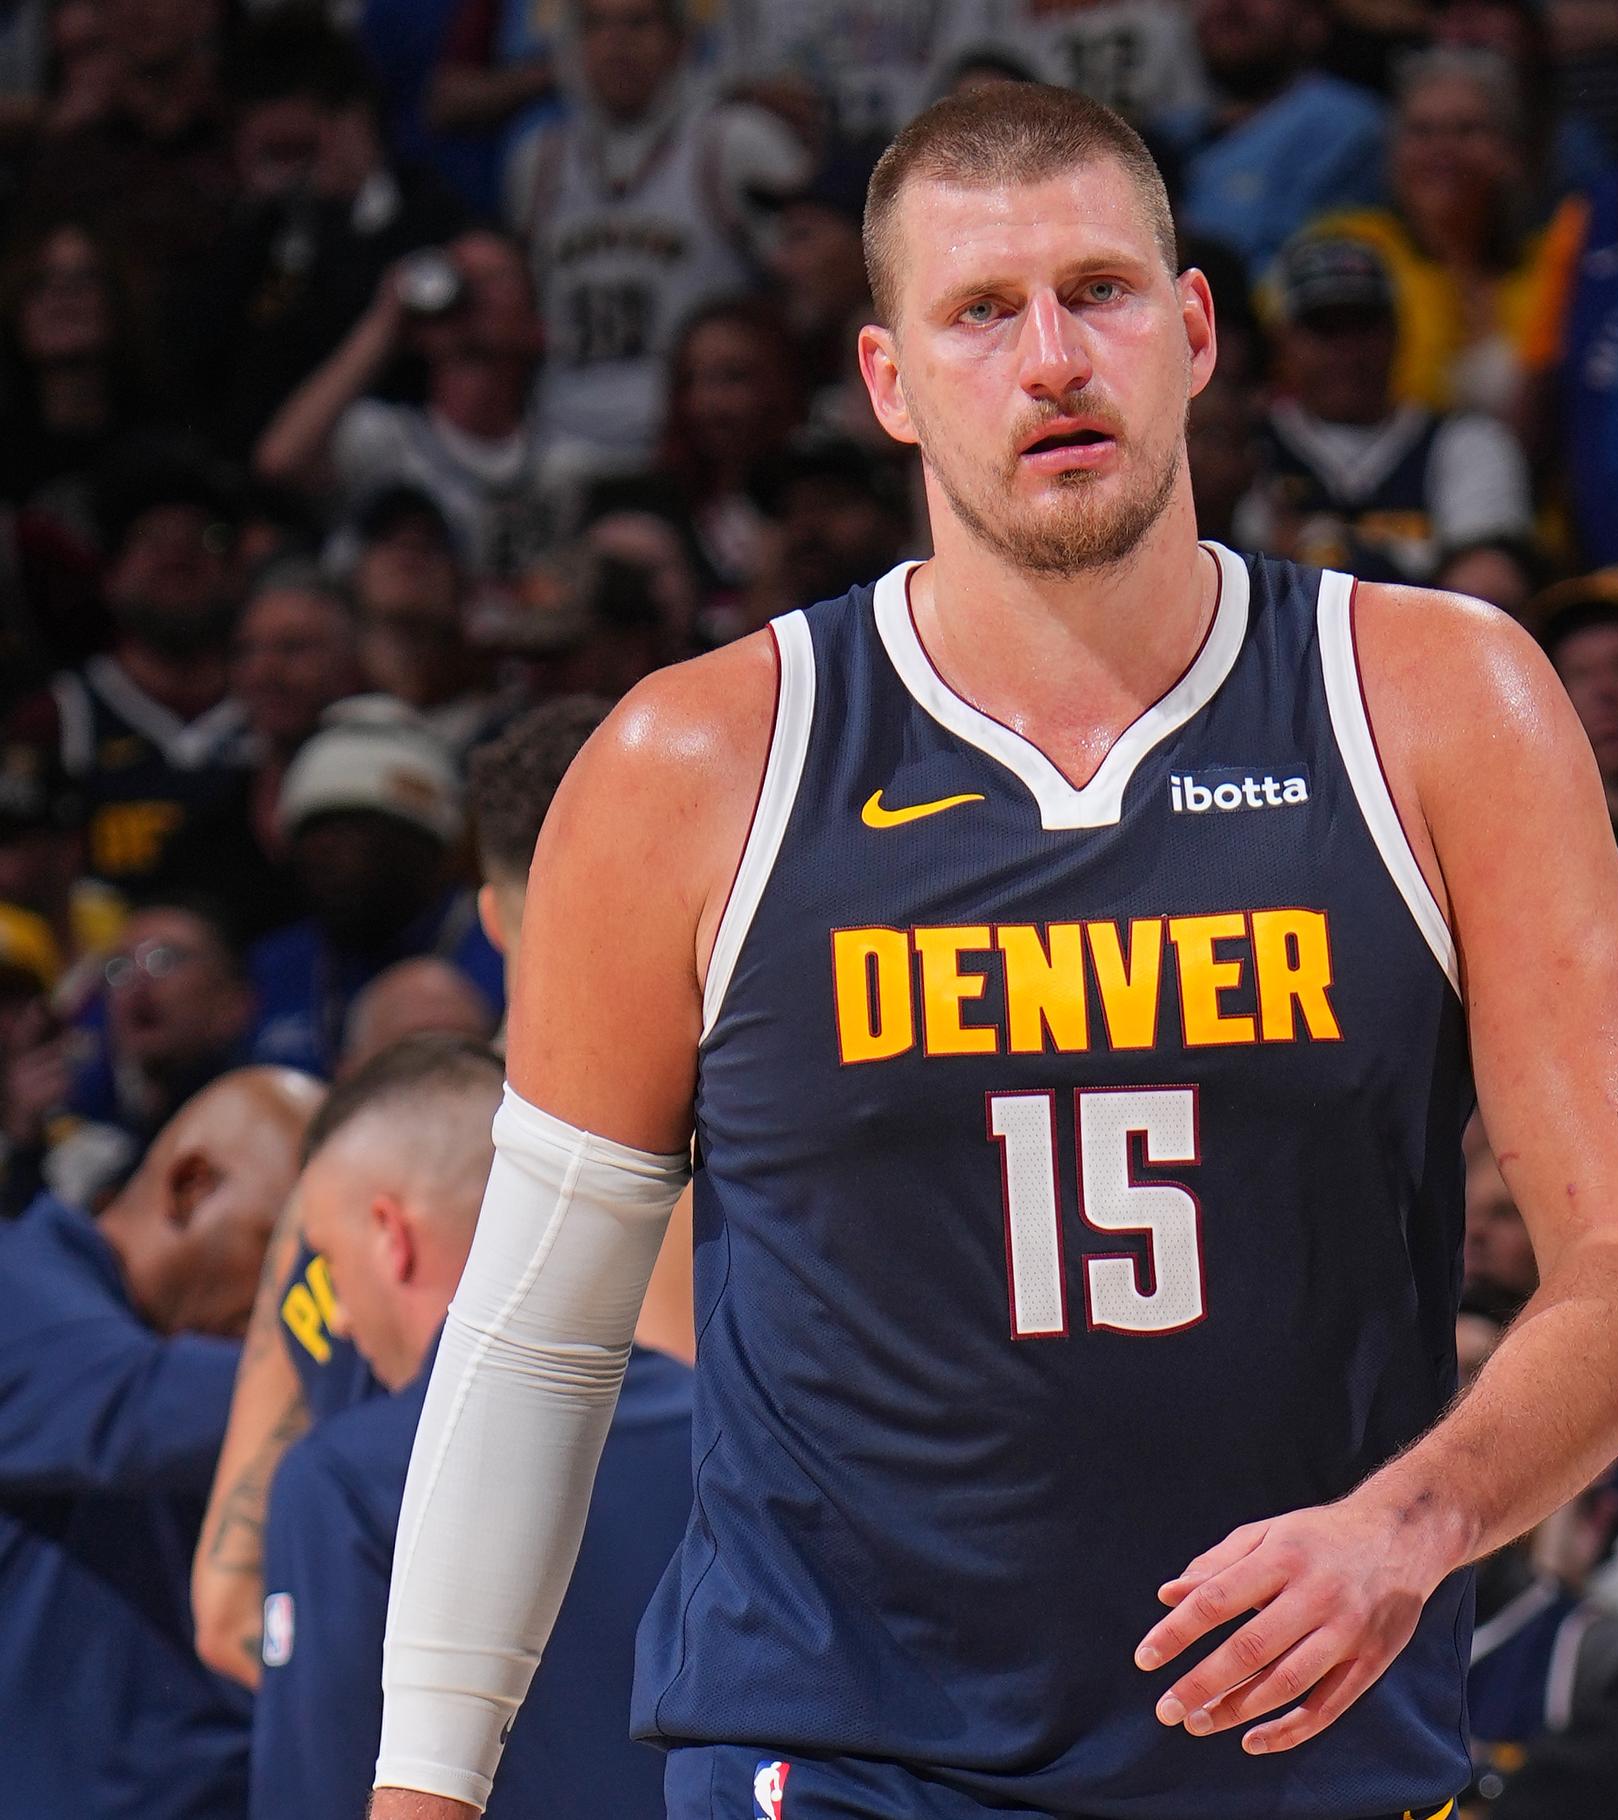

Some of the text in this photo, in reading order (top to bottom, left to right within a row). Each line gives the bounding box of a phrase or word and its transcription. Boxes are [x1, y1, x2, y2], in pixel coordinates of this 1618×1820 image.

[1170, 774, 1308, 812] ibotta
[830, 907, 1344, 1066] DENVER
[985, 1084, 1208, 1340] 15
